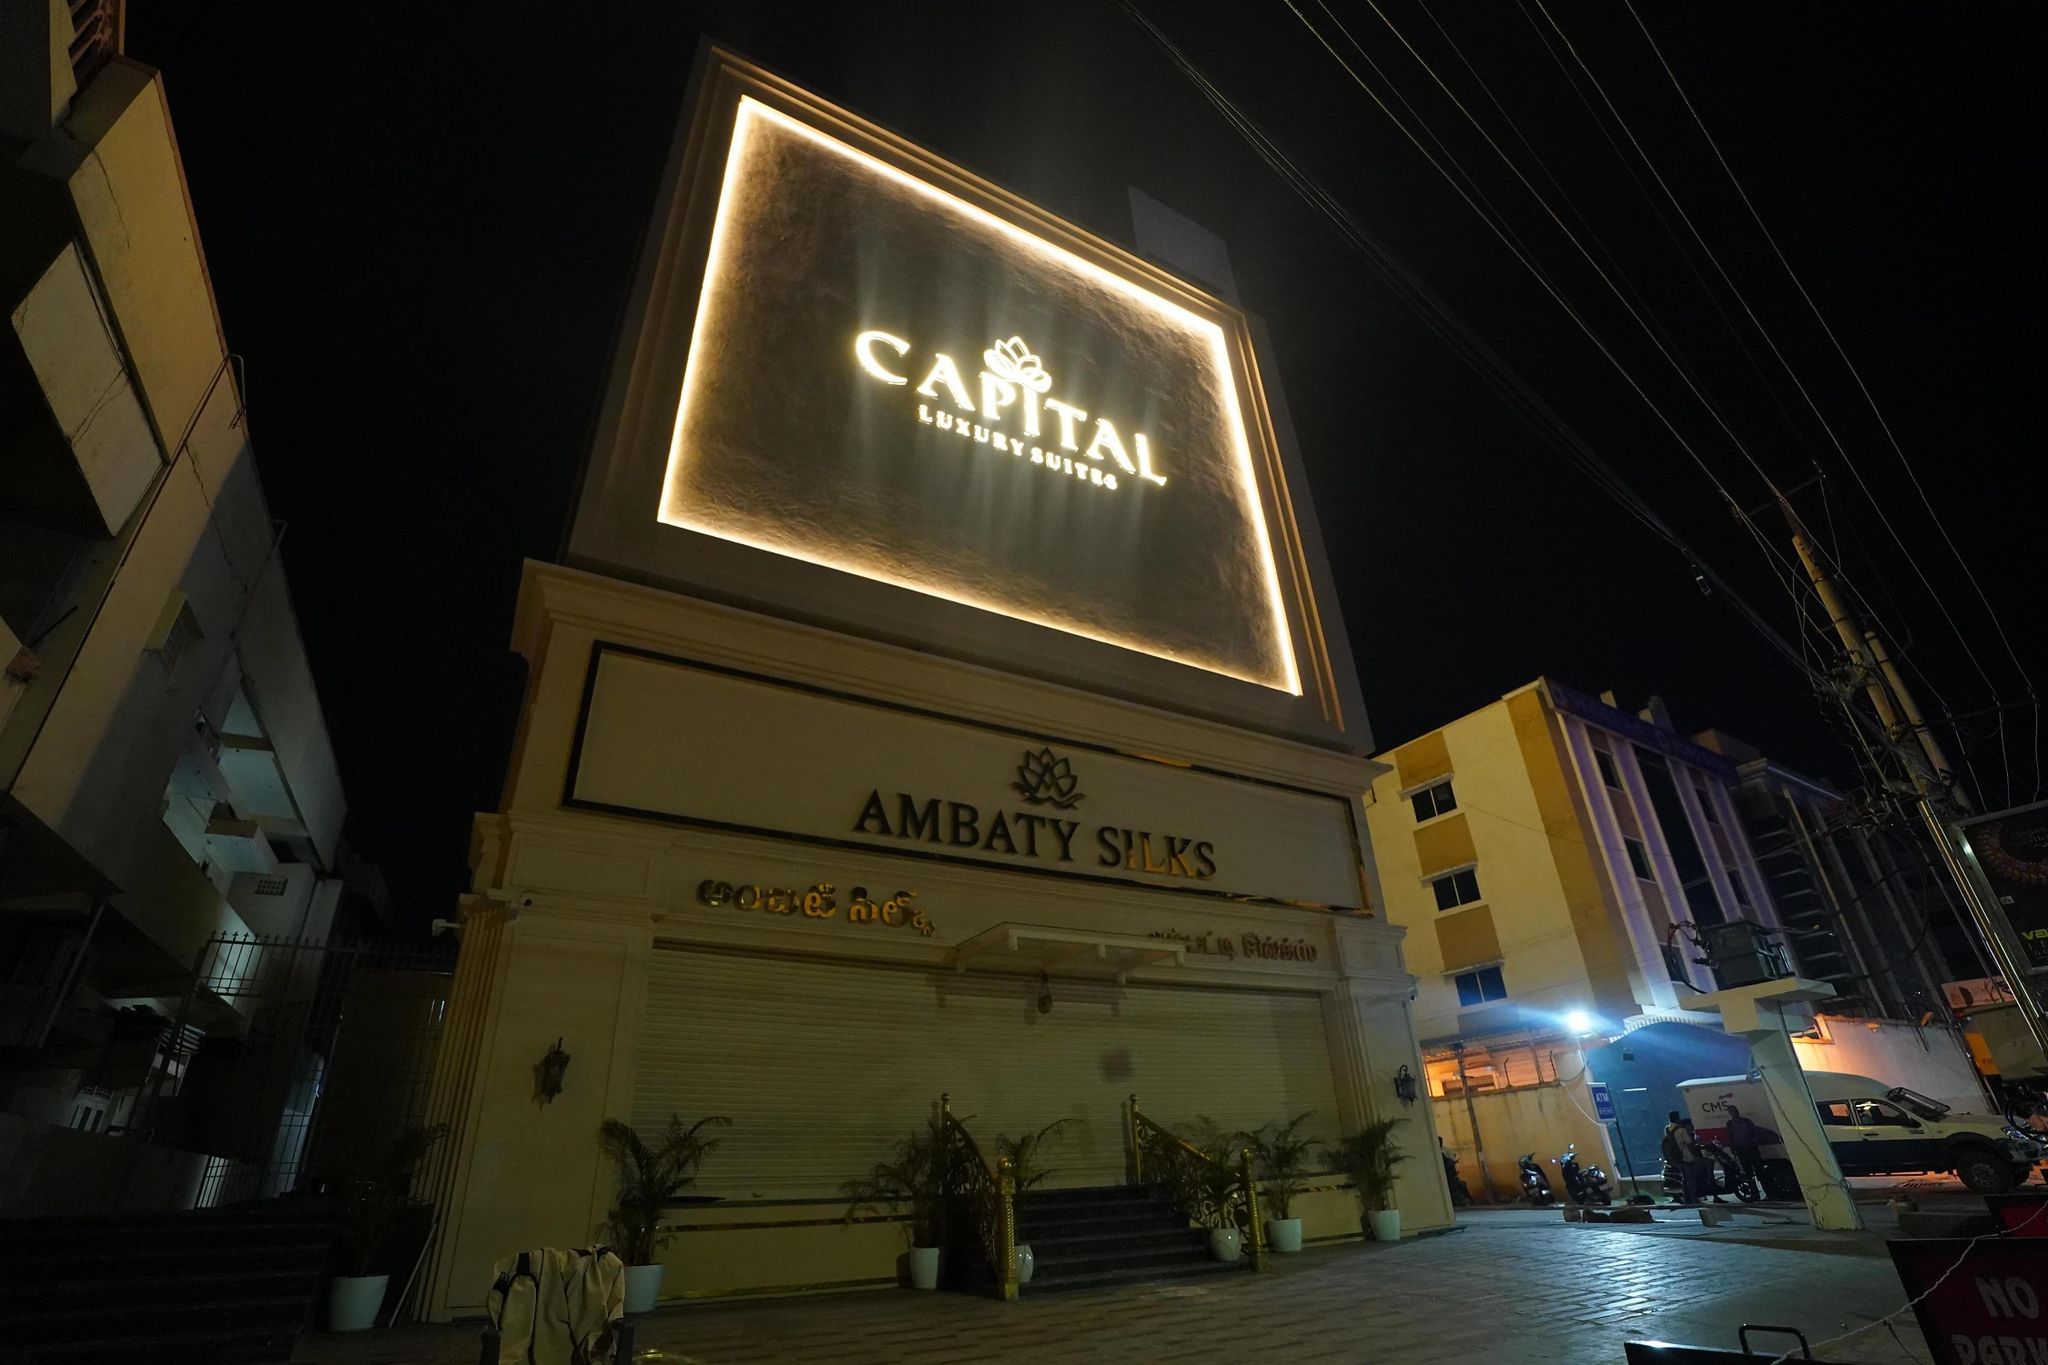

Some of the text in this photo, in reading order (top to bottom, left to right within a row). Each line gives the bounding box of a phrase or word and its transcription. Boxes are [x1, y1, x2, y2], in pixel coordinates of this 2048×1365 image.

[855, 330, 1168, 487] CAPITAL
[918, 404, 1118, 490] LUXURY SUITES
[853, 788, 1217, 881] AMBATY SILKS
[1595, 1092, 1610, 1103] ATM
[1702, 1101, 1729, 1112] CMS
[1975, 1276, 2040, 1319] NO
